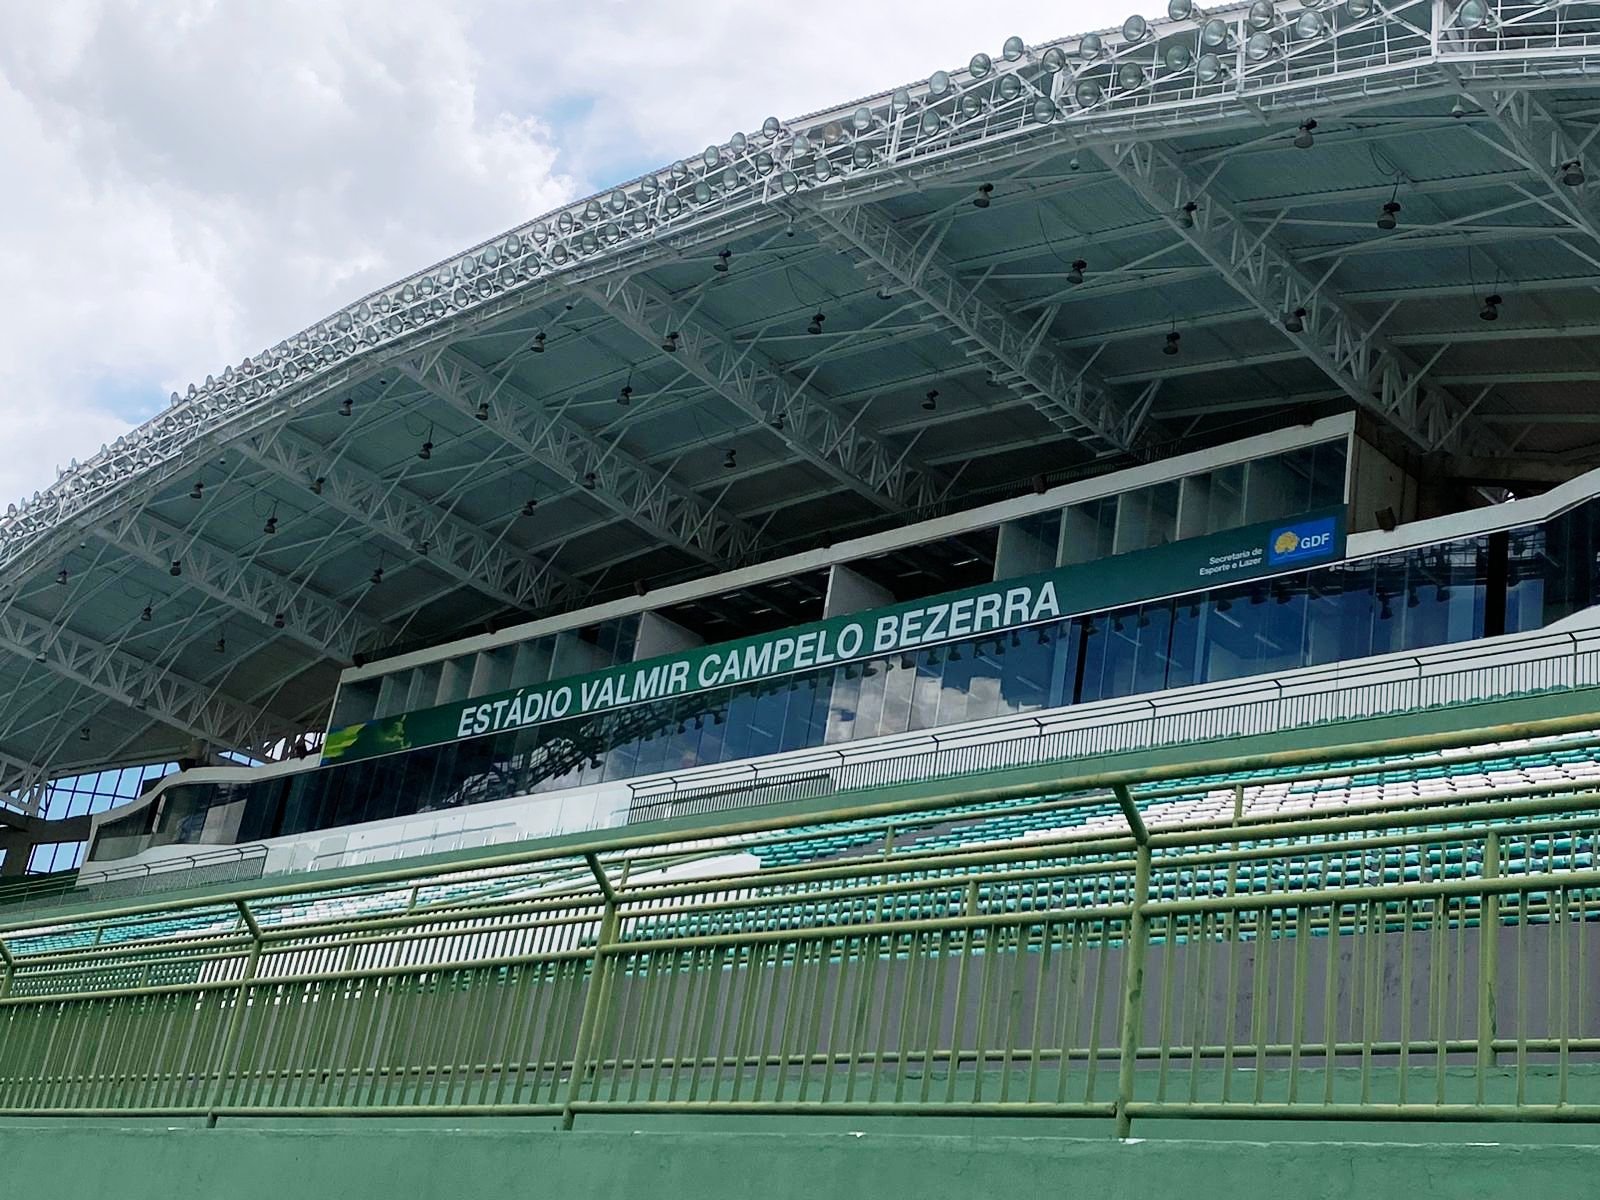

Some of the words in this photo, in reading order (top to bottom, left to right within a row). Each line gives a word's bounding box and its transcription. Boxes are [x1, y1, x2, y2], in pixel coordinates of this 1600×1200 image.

[1301, 533, 1330, 548] GDF
[1209, 550, 1250, 564] Secretaria
[1252, 547, 1262, 555] de
[1200, 564, 1230, 576] Esporte
[1239, 558, 1262, 568] Lazer
[457, 687, 572, 738] ESTÁDIO
[580, 660, 690, 712] VALMIR
[697, 624, 864, 687] CAMPELO
[873, 581, 1060, 651] BEZERRA
